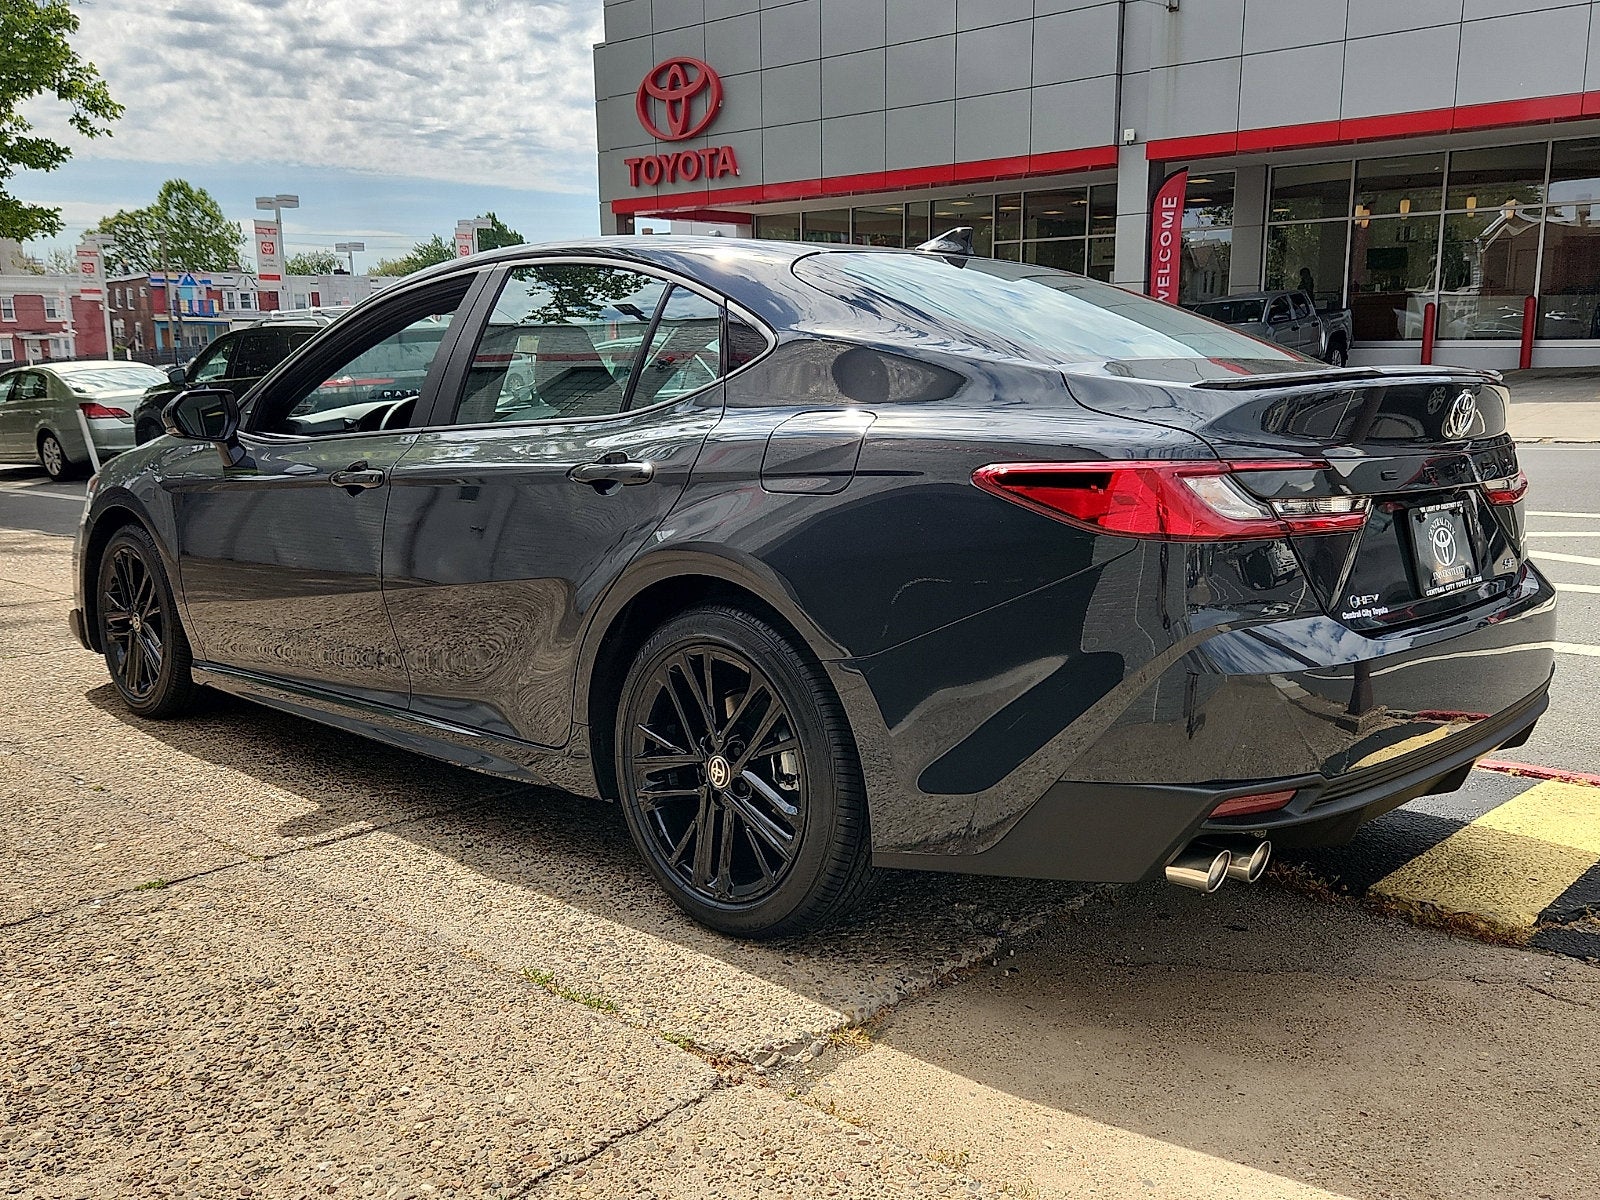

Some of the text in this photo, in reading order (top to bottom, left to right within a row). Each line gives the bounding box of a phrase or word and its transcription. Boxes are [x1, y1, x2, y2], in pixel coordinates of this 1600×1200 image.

[624, 145, 739, 188] TOYOTA
[1426, 587, 1445, 597] CENTRAL
[1342, 606, 1388, 620] Central City Toyota
